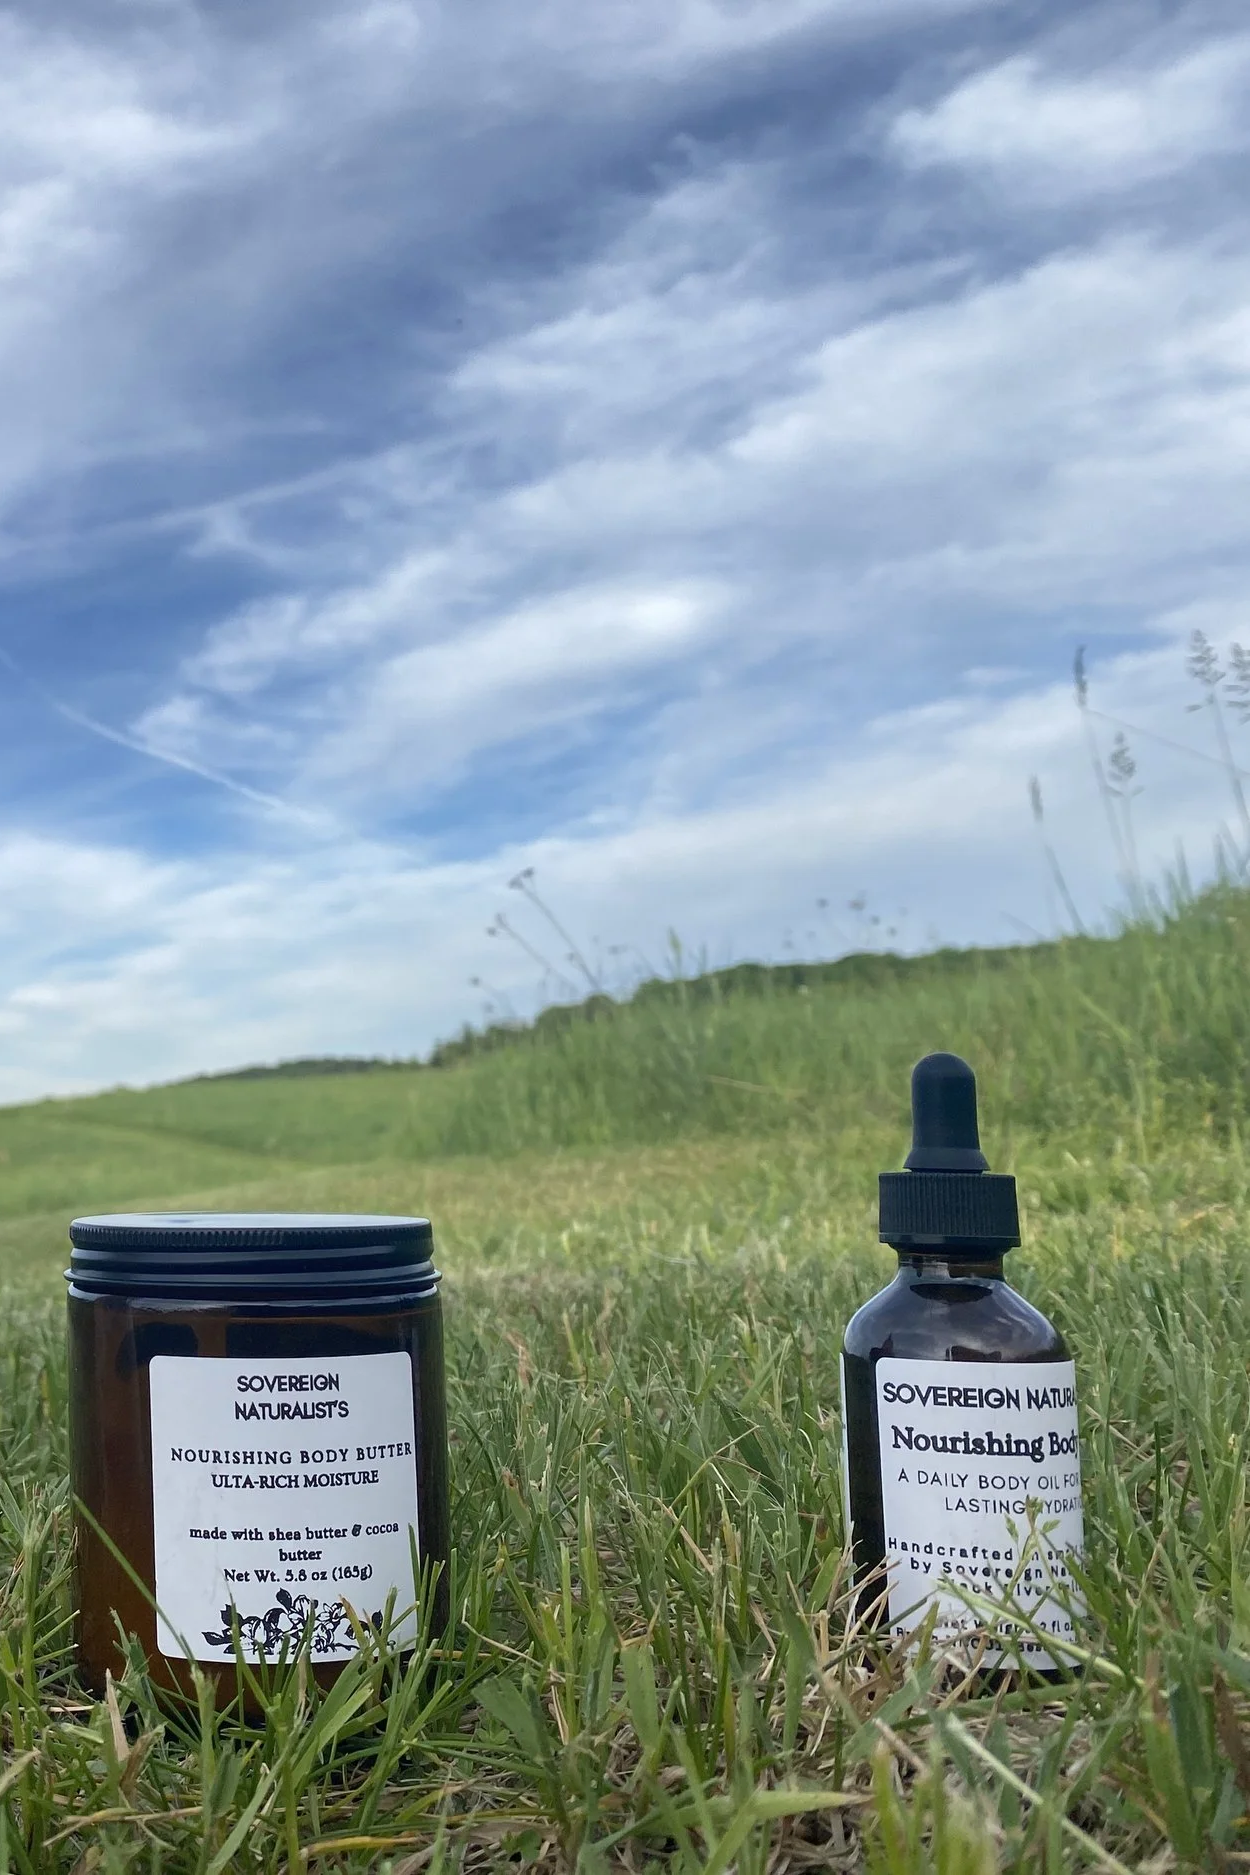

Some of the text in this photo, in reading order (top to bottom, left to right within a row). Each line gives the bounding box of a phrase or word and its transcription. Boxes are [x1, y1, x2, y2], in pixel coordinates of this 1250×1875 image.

[237, 1372, 340, 1393] SOVEREIGN
[883, 1382, 1021, 1412] SOVEREIGN
[235, 1401, 349, 1421] NATURALIST'S
[171, 1442, 412, 1465] NOURISHING BODY BUTTER
[891, 1424, 1045, 1463] Nourishing
[211, 1470, 379, 1489] ULTA-RICH MOISTURE
[898, 1468, 909, 1483] A
[917, 1470, 969, 1488] DAILY
[979, 1475, 1030, 1490] BODY
[1037, 1475, 1060, 1490] OIL
[945, 1497, 1026, 1514] LASTING
[189, 1527, 227, 1540] made
[231, 1528, 264, 1541] with
[268, 1528, 301, 1541] shea
[305, 1527, 348, 1540] butter
[365, 1522, 399, 1536] cocoa
[279, 1549, 323, 1562] butter
[888, 1537, 1013, 1561] Handcrafted
[224, 1569, 251, 1583] Net
[254, 1569, 281, 1583] Wt.
[311, 1571, 328, 1581] oz
[911, 1557, 932, 1574] by
[942, 1561, 1043, 1581] Soveregn
